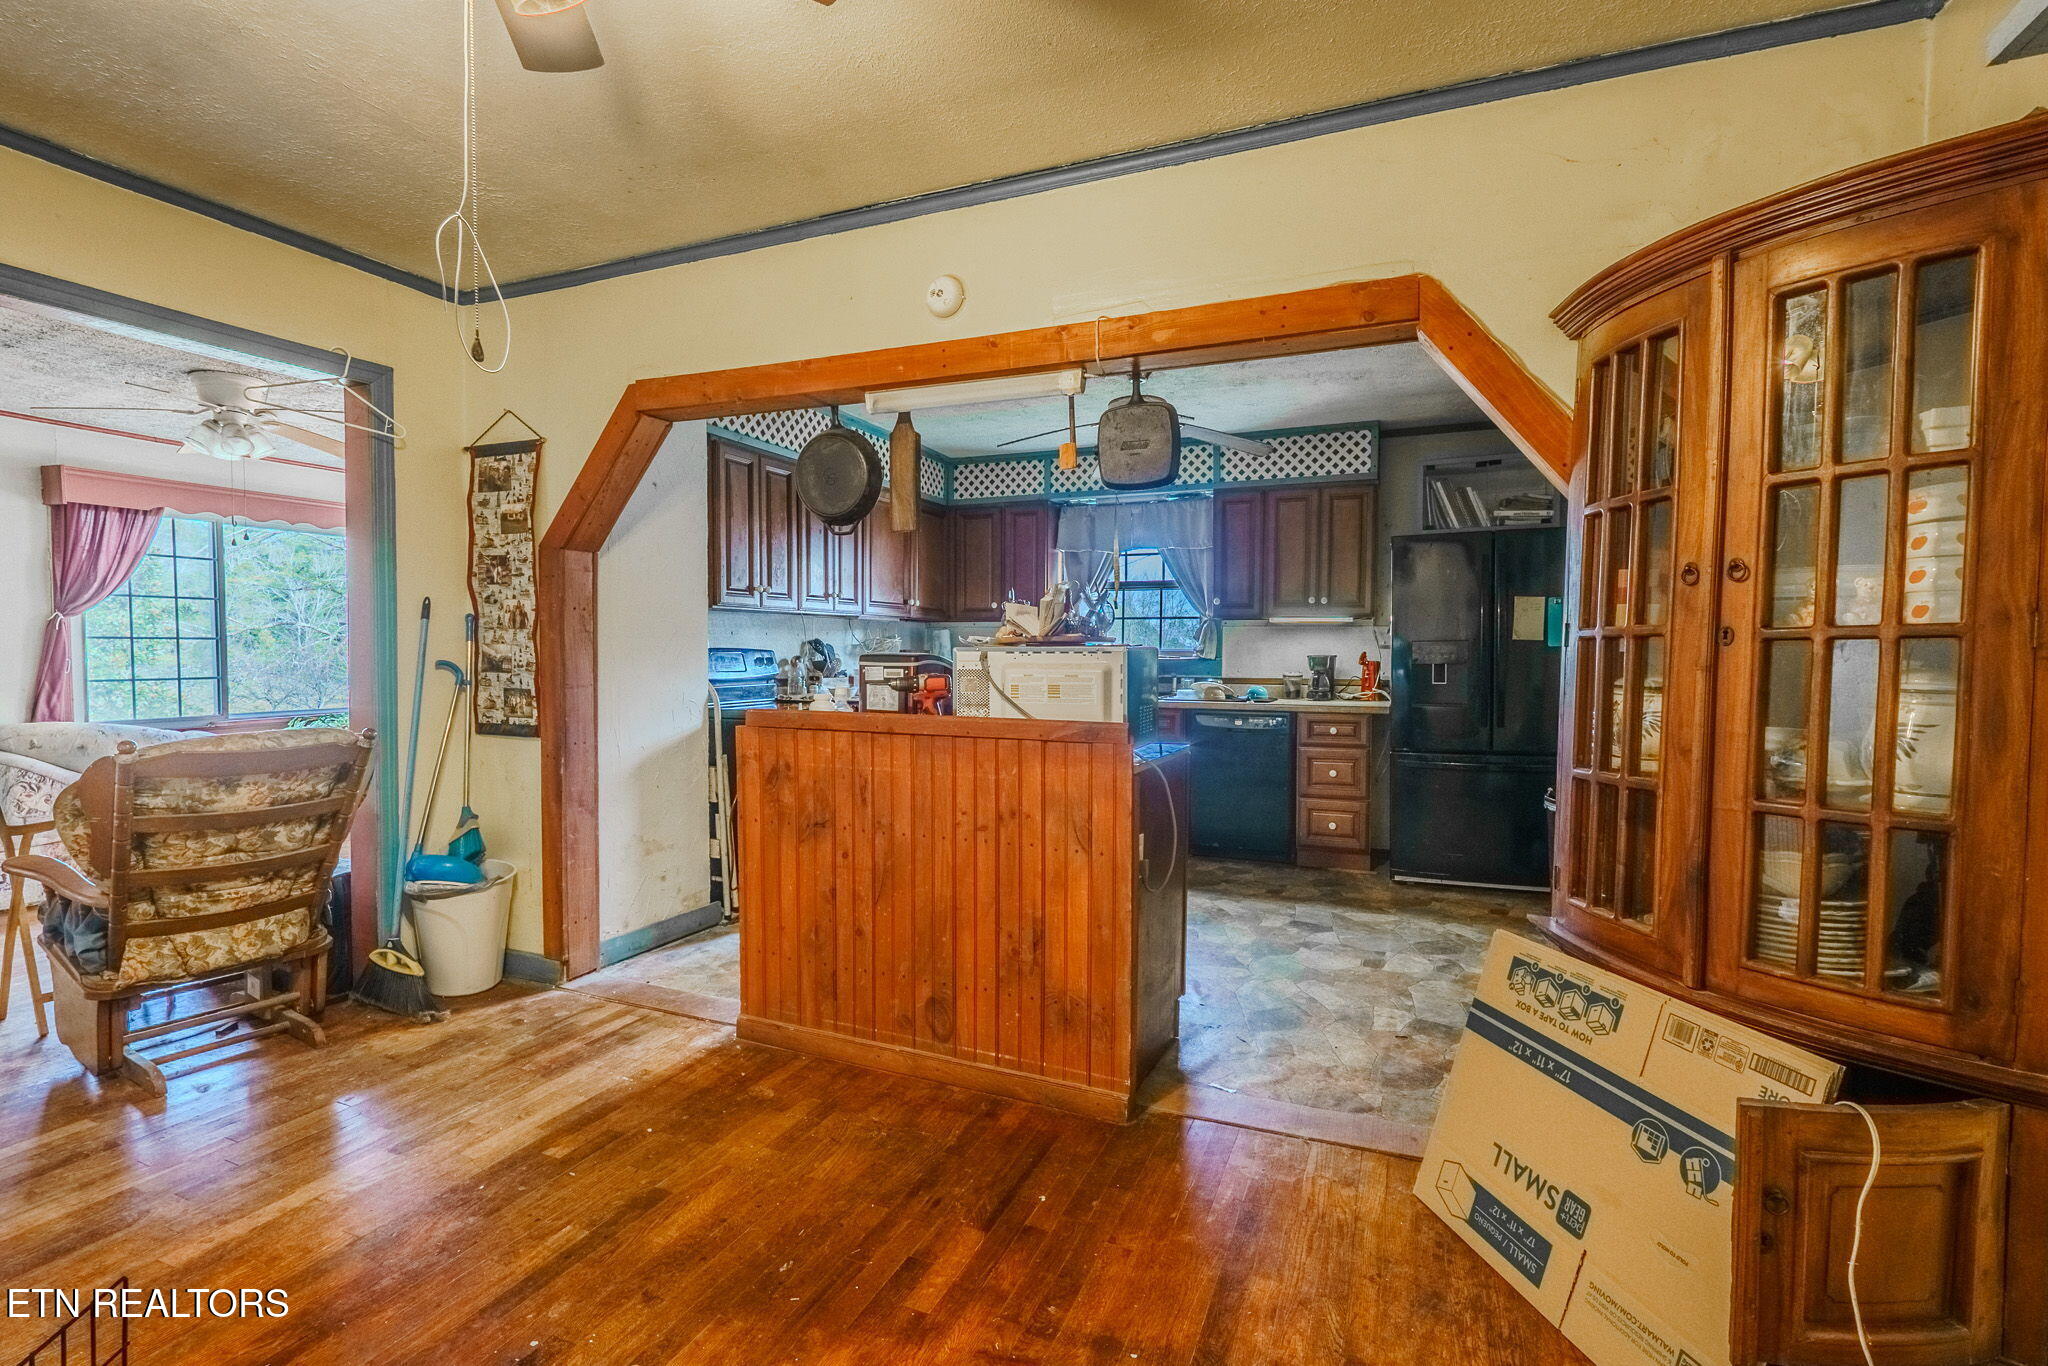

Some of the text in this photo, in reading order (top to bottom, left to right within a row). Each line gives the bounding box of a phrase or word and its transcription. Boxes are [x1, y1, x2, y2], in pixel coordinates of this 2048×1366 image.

[1515, 999, 1531, 1013] BOX
[1538, 1011, 1557, 1027] TAPE
[1558, 1022, 1569, 1034] TO
[1570, 1029, 1592, 1045] HOW
[1507, 1040, 1571, 1084] 17" x 11" x 12"
[1493, 1142, 1560, 1210] SMALL
[1564, 1197, 1586, 1222] GEAR
[1472, 1211, 1503, 1241] PEQUEÑO
[1488, 1205, 1535, 1248] 17" x 11" x 12"
[1509, 1242, 1537, 1273] SMALL
[1588, 1281, 1675, 1357] WALMART.COM/MOVING
